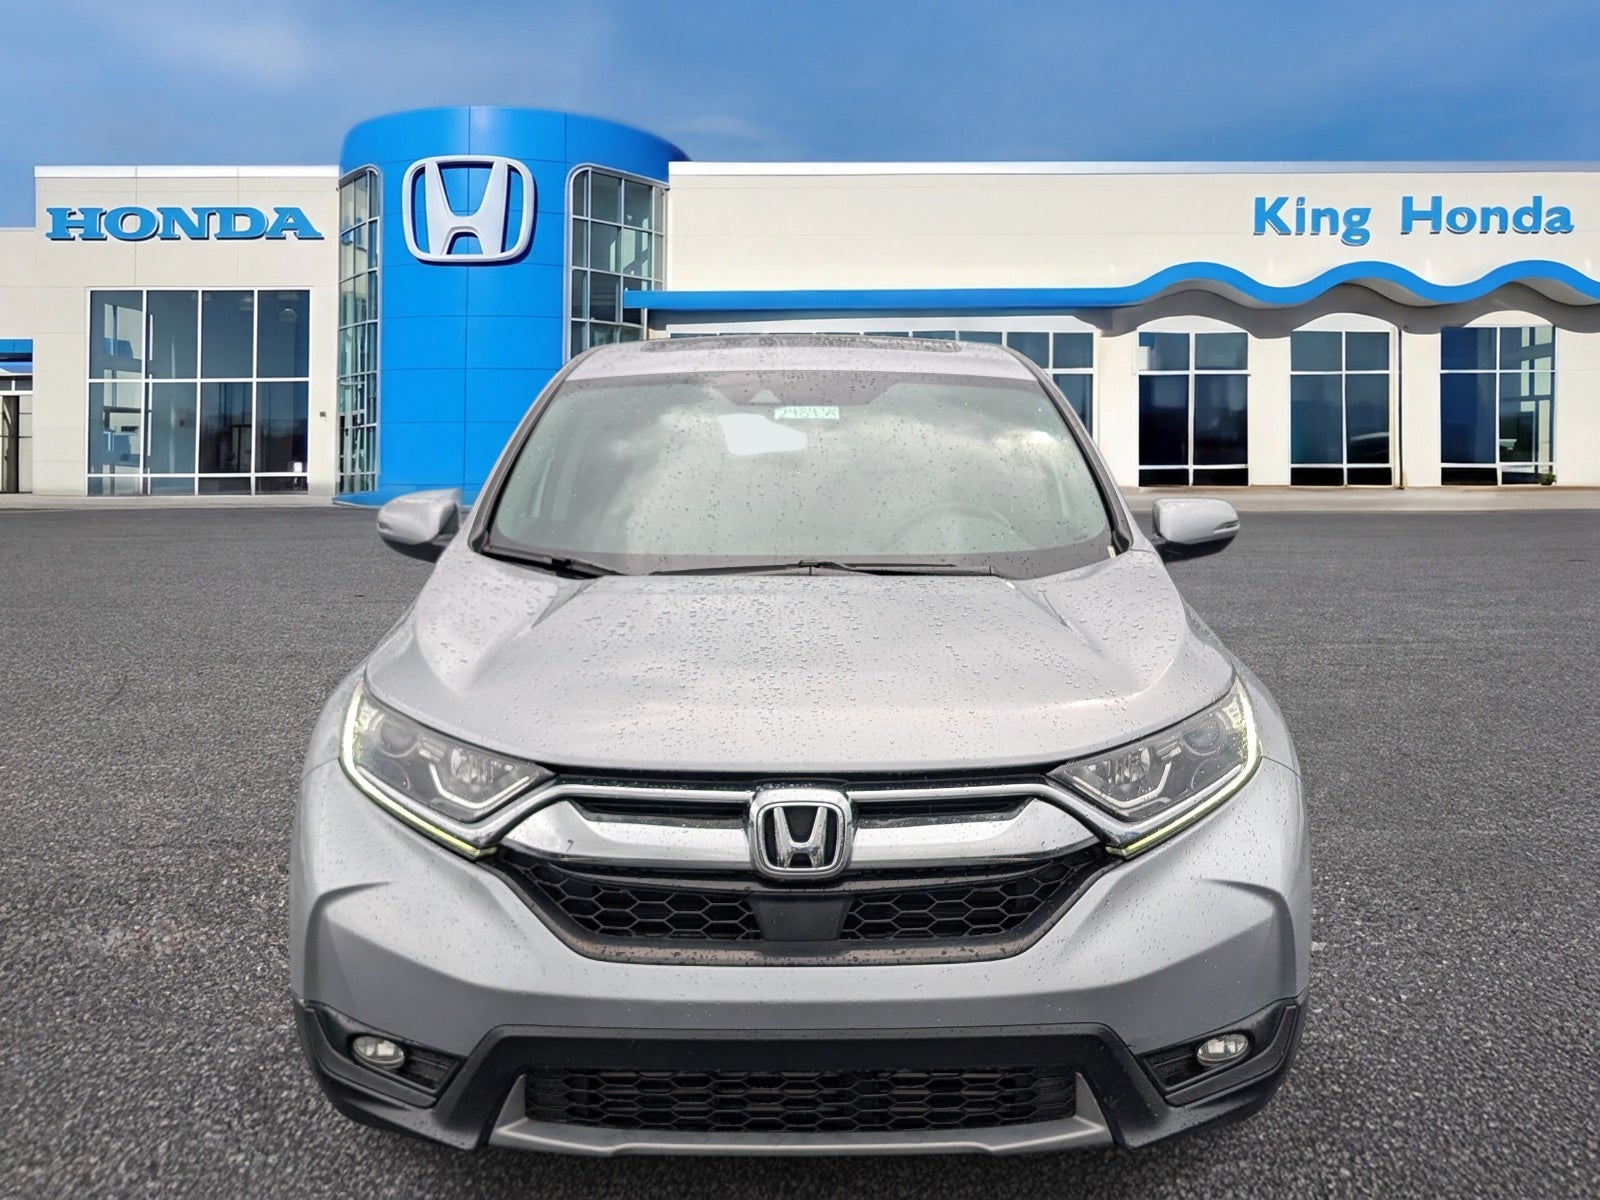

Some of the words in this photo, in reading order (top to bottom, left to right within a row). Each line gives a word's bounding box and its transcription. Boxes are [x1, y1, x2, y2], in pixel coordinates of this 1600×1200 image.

[46, 206, 324, 241] HONDA
[1253, 196, 1372, 246] King
[1400, 195, 1574, 234] Honda
